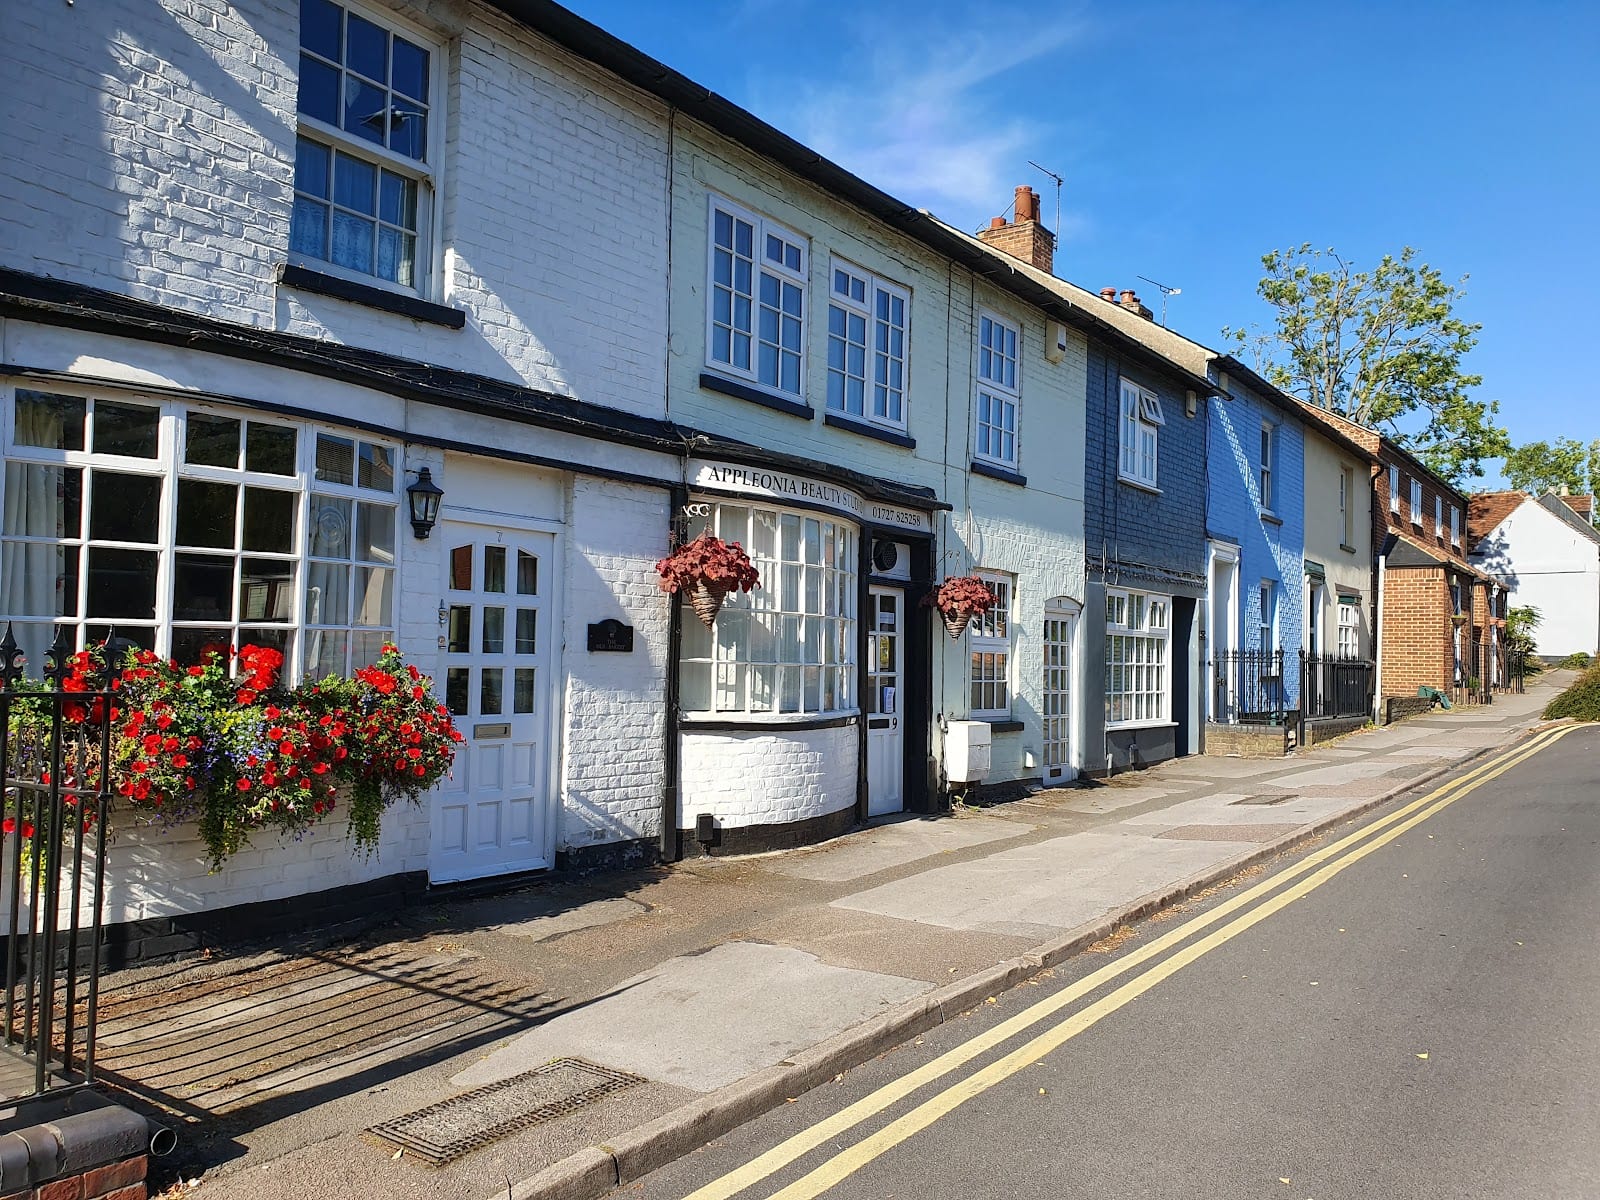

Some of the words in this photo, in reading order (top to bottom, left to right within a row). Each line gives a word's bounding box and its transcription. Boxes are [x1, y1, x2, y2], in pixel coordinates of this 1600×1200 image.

[708, 466, 797, 494] APPLEONIA
[801, 482, 841, 504] BEAUTY
[872, 506, 895, 521] 01727
[896, 512, 921, 527] 825258
[891, 717, 898, 730] 9
